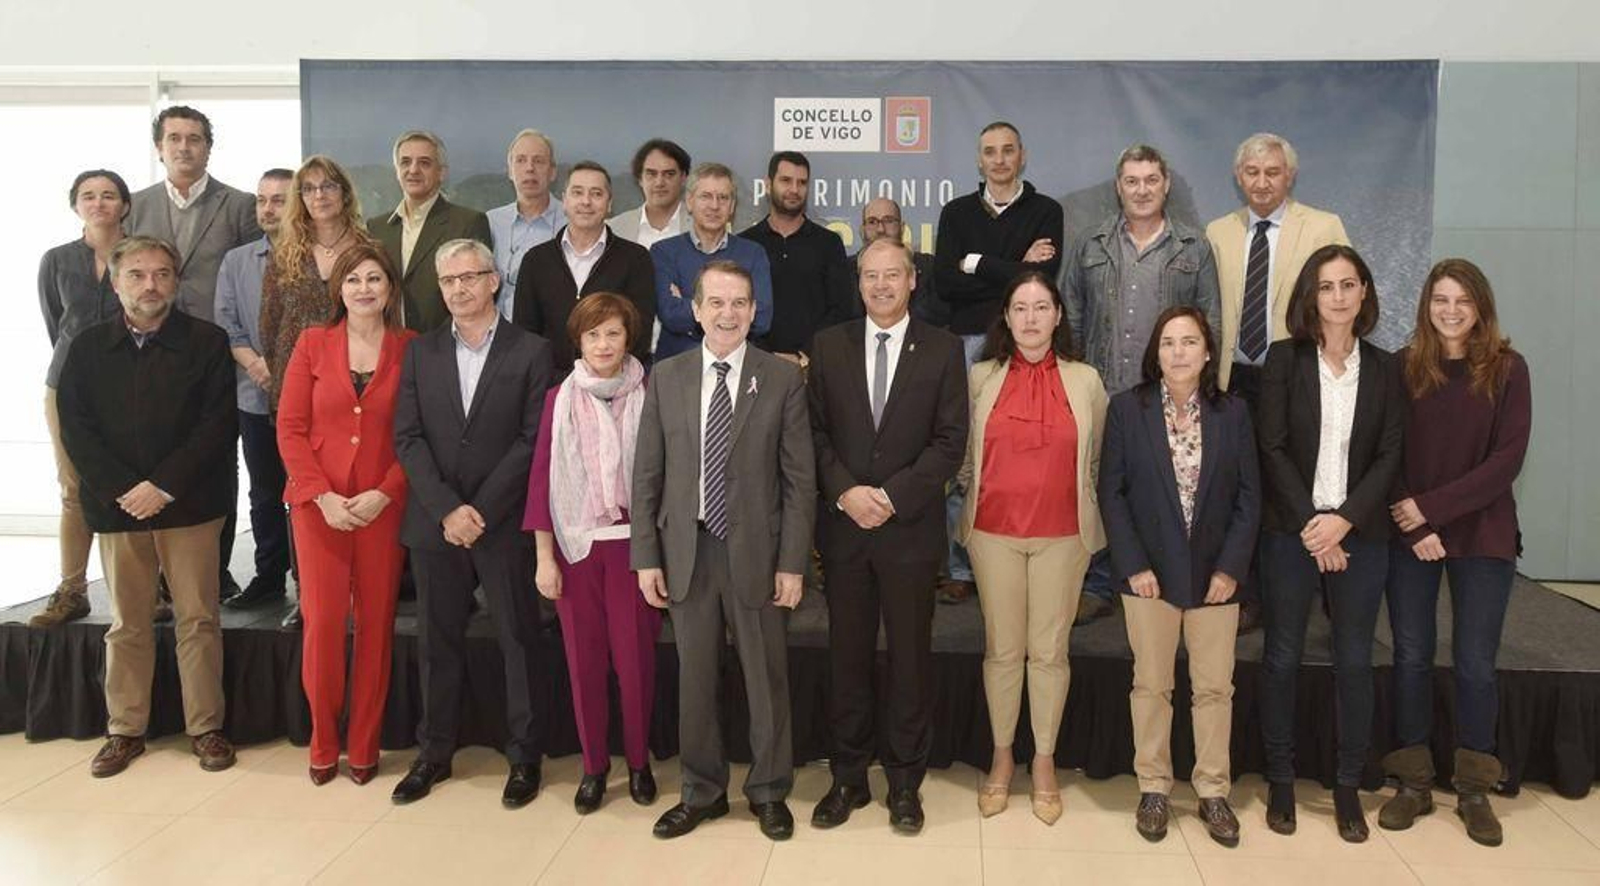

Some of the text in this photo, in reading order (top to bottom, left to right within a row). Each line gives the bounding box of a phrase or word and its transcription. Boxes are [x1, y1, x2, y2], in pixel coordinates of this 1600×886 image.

[781, 109, 873, 123] CONCELLO
[792, 126, 862, 140] DE VIGO
[752, 178, 955, 207] PRIMONIO
